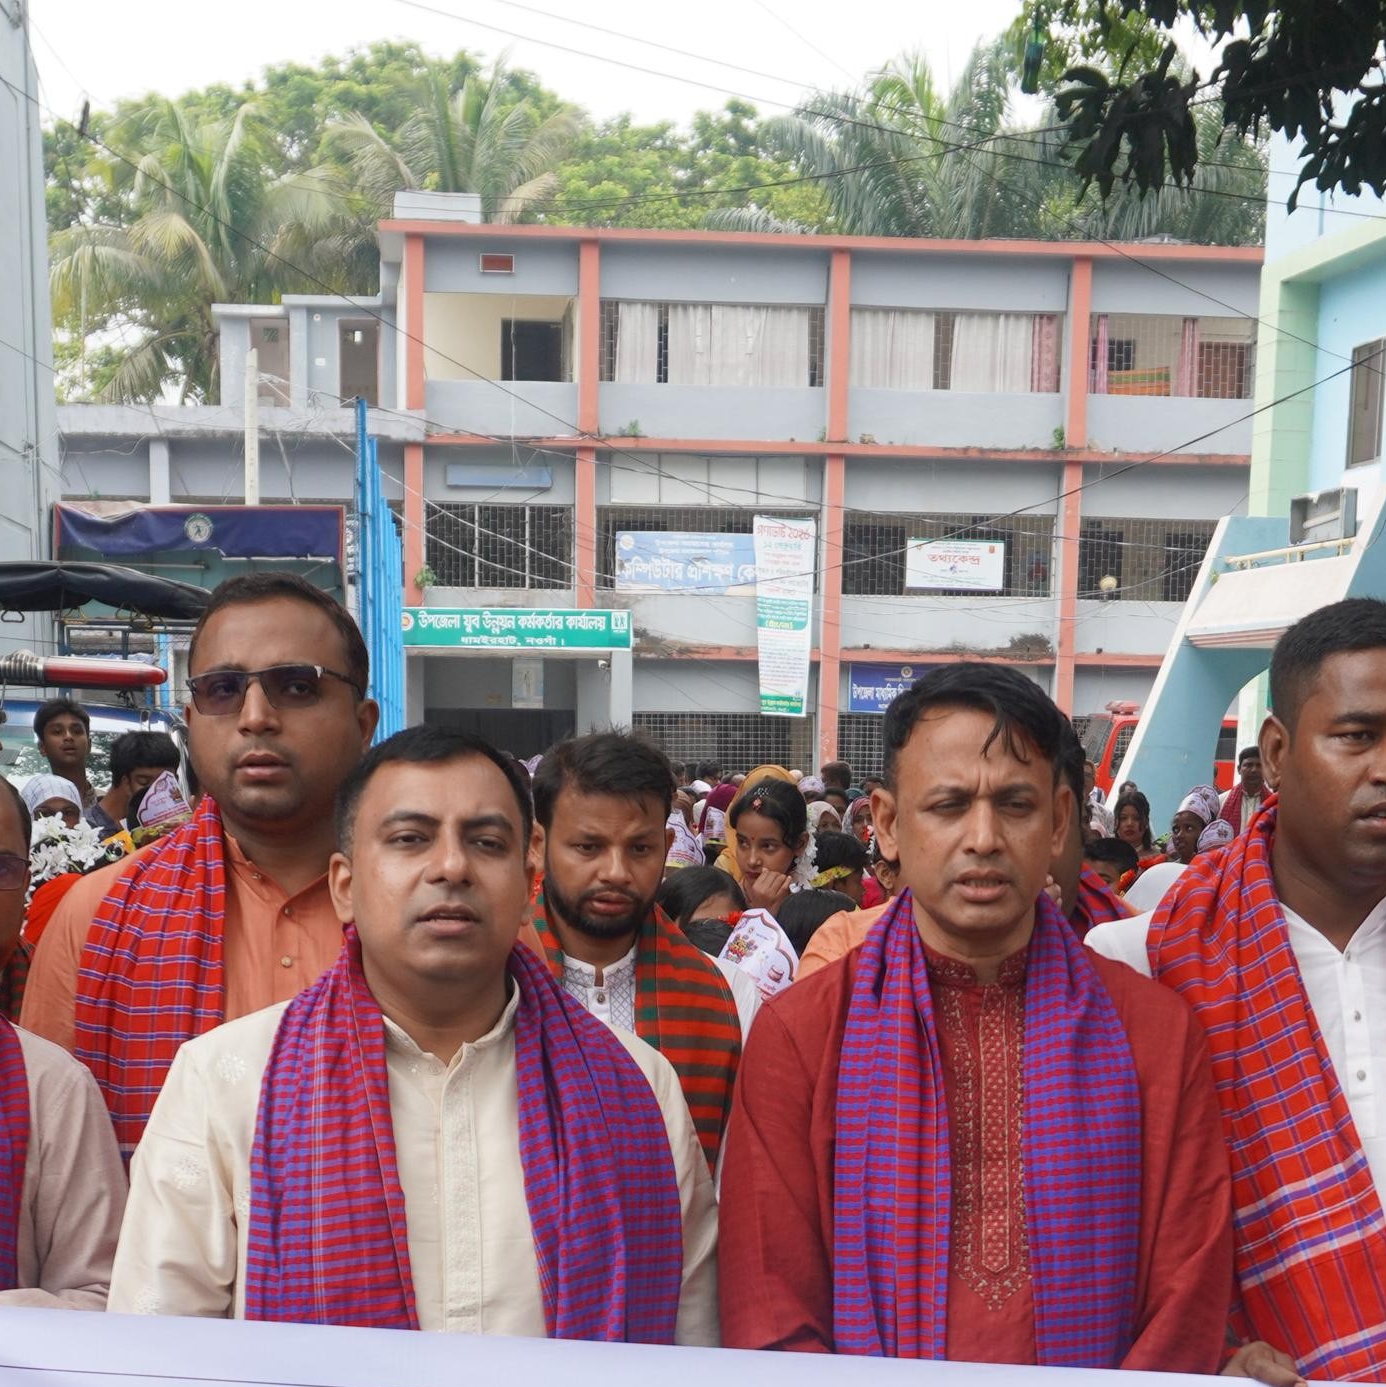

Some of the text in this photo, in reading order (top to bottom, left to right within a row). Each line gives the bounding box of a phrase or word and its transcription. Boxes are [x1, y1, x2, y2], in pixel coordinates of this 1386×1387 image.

[418, 611, 460, 628] উপজেলা
[464, 614, 480, 633] যুব
[518, 613, 563, 631] কর্মকর্তার
[566, 614, 606, 631] কার্যালয়
